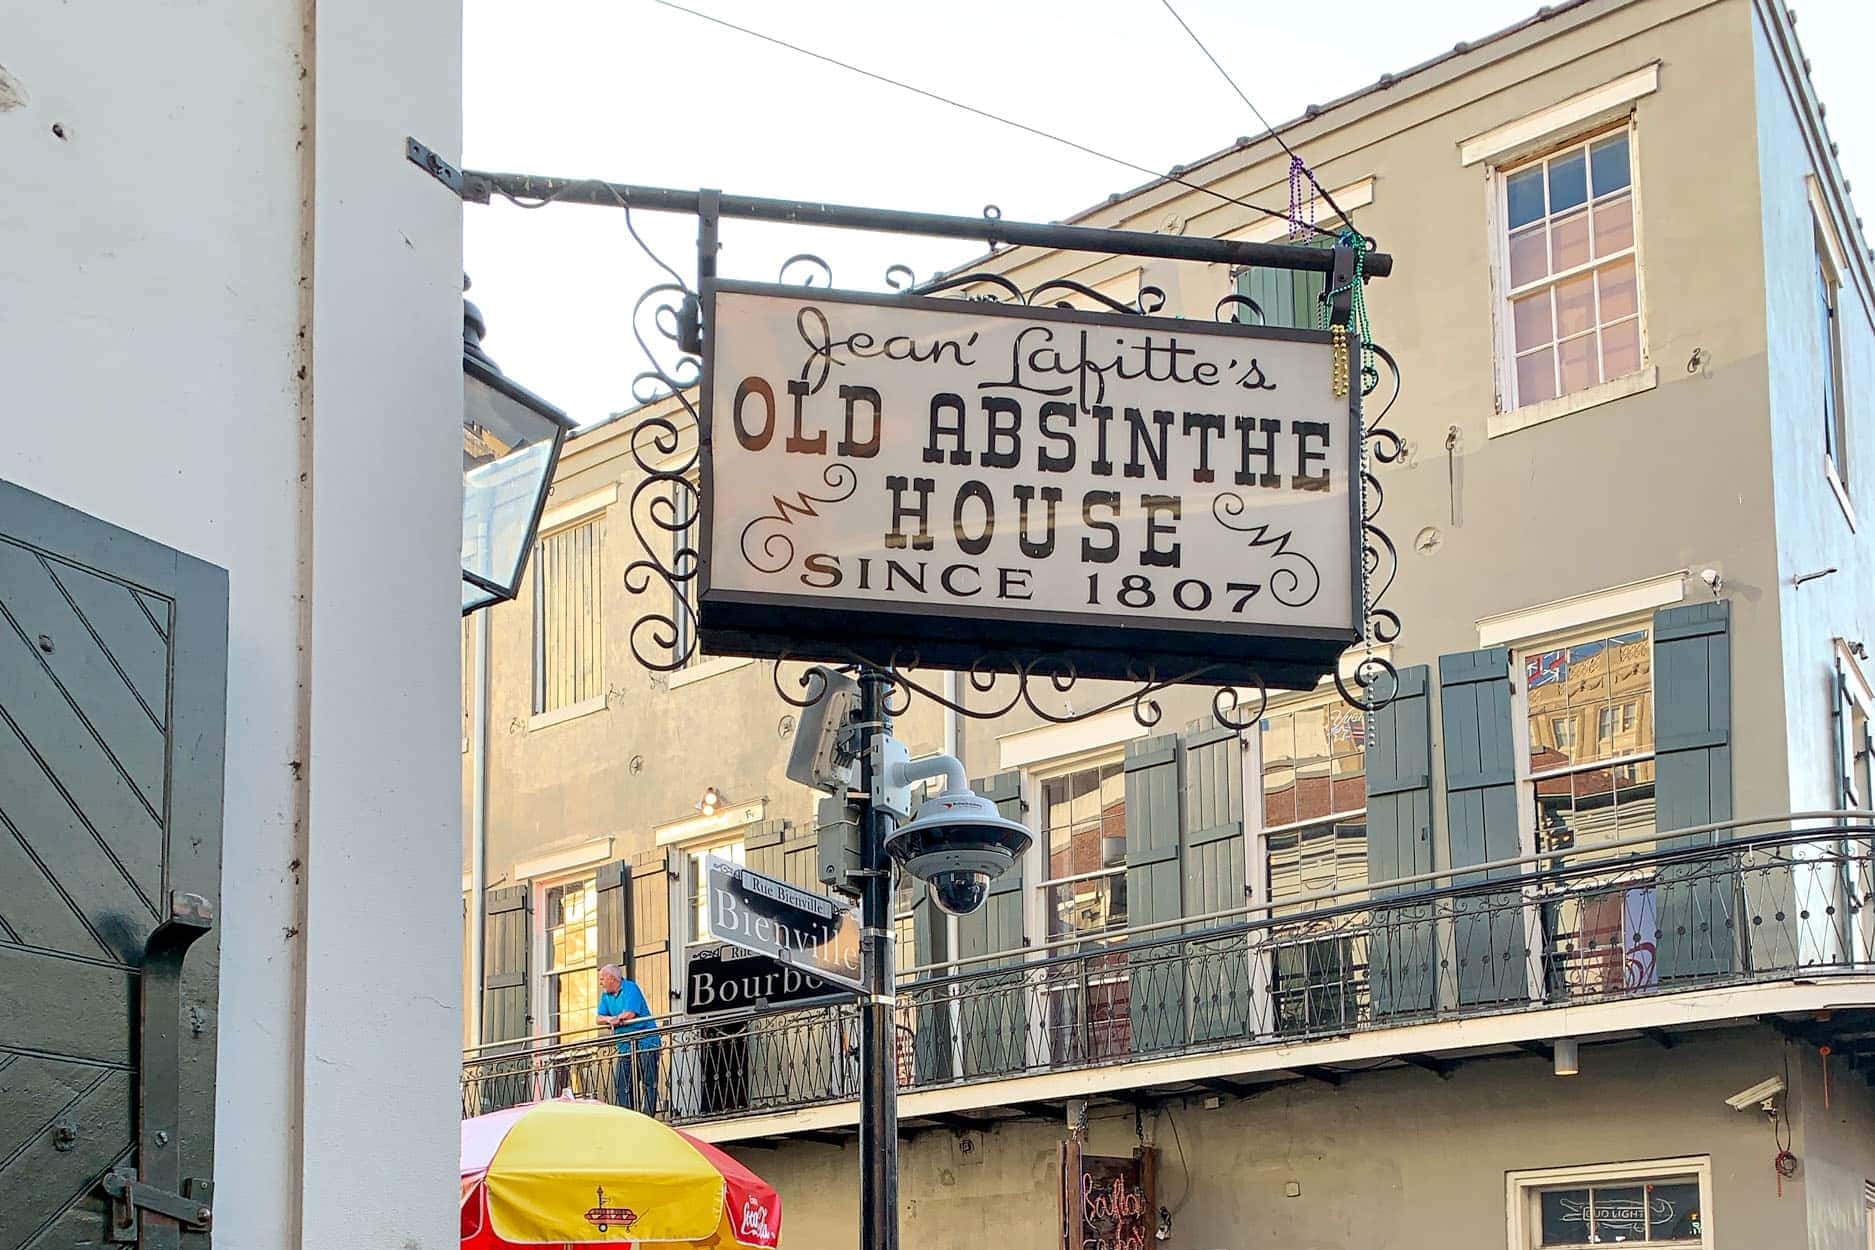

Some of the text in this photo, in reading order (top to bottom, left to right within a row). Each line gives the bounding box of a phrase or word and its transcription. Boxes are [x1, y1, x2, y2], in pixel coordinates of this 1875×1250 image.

[977, 326, 1278, 414] Lafitte's
[733, 376, 1331, 493] OLD ABSINTHE
[885, 475, 1182, 568] HOUSE
[800, 553, 1262, 613] SINCE 1807
[715, 888, 858, 970] Bienville
[752, 877, 825, 913] Rue Bienville
[691, 967, 823, 1007] Bourbo
